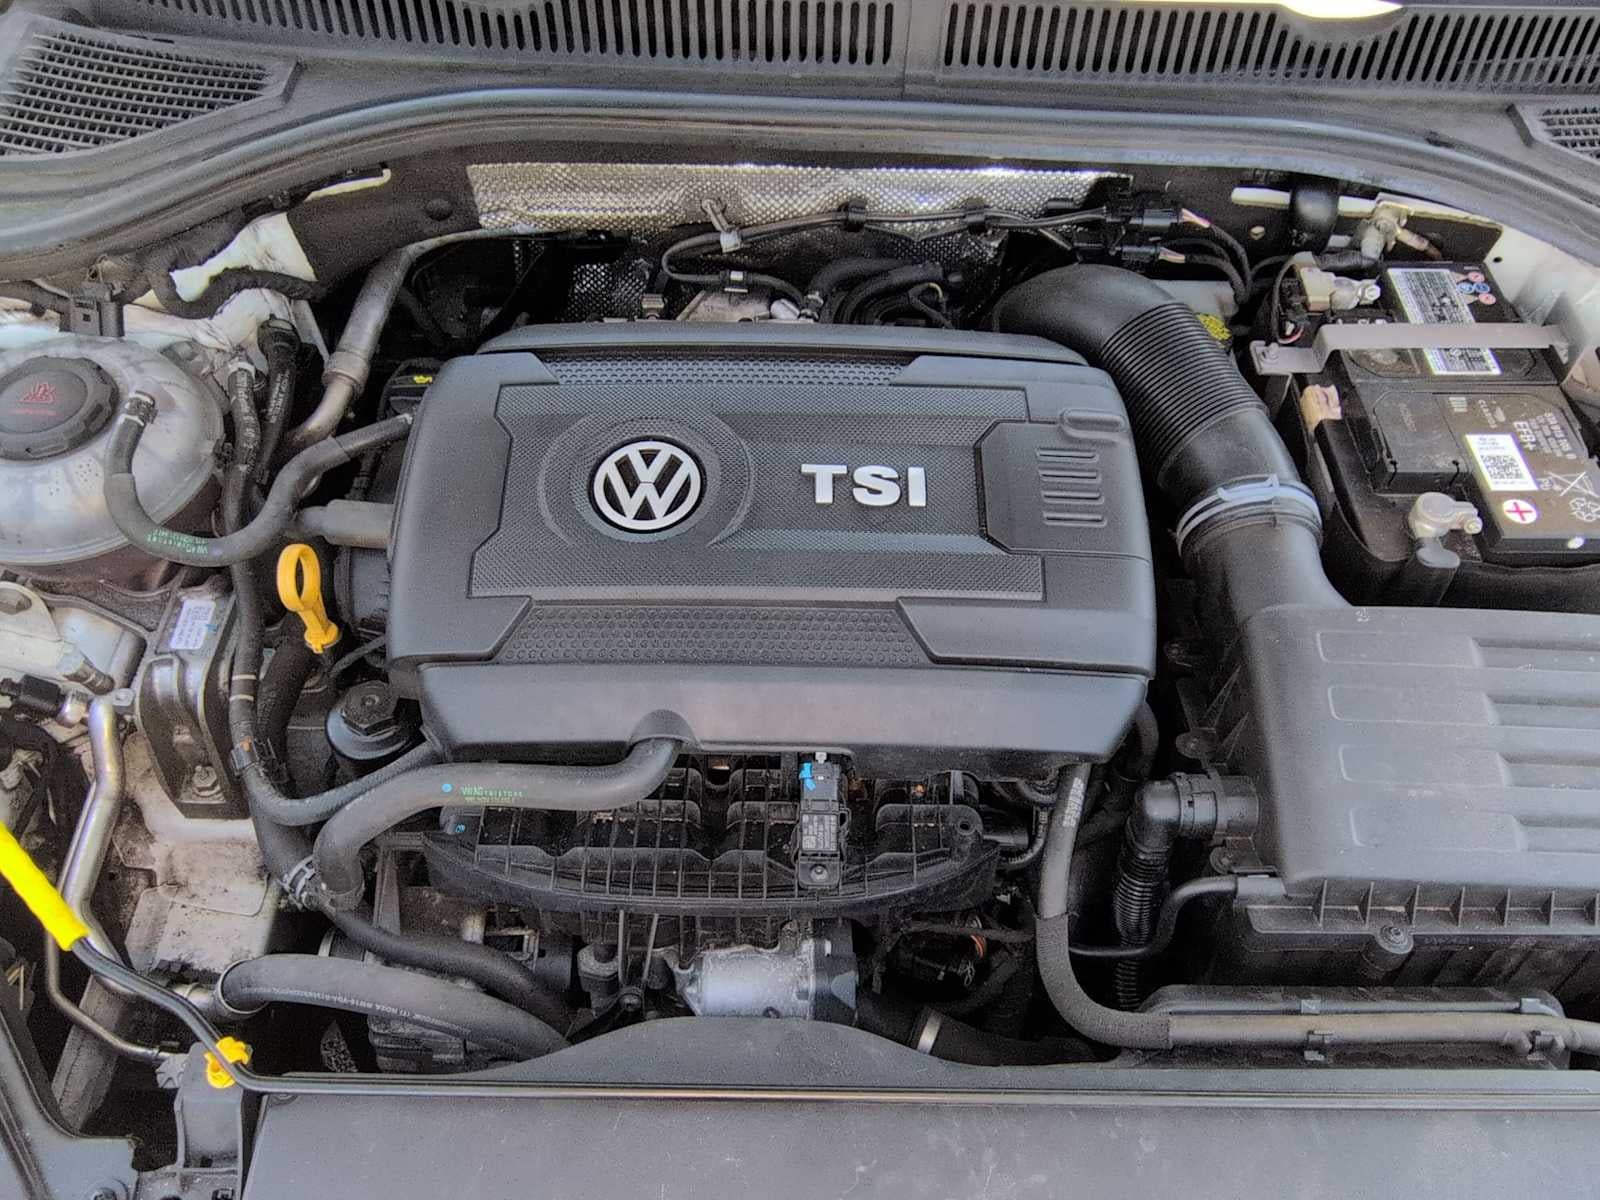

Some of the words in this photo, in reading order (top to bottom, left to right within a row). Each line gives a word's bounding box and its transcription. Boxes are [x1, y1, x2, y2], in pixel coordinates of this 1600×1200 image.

[1513, 421, 1537, 451] EFB+
[594, 441, 701, 529] VW
[801, 464, 926, 507] TSI
